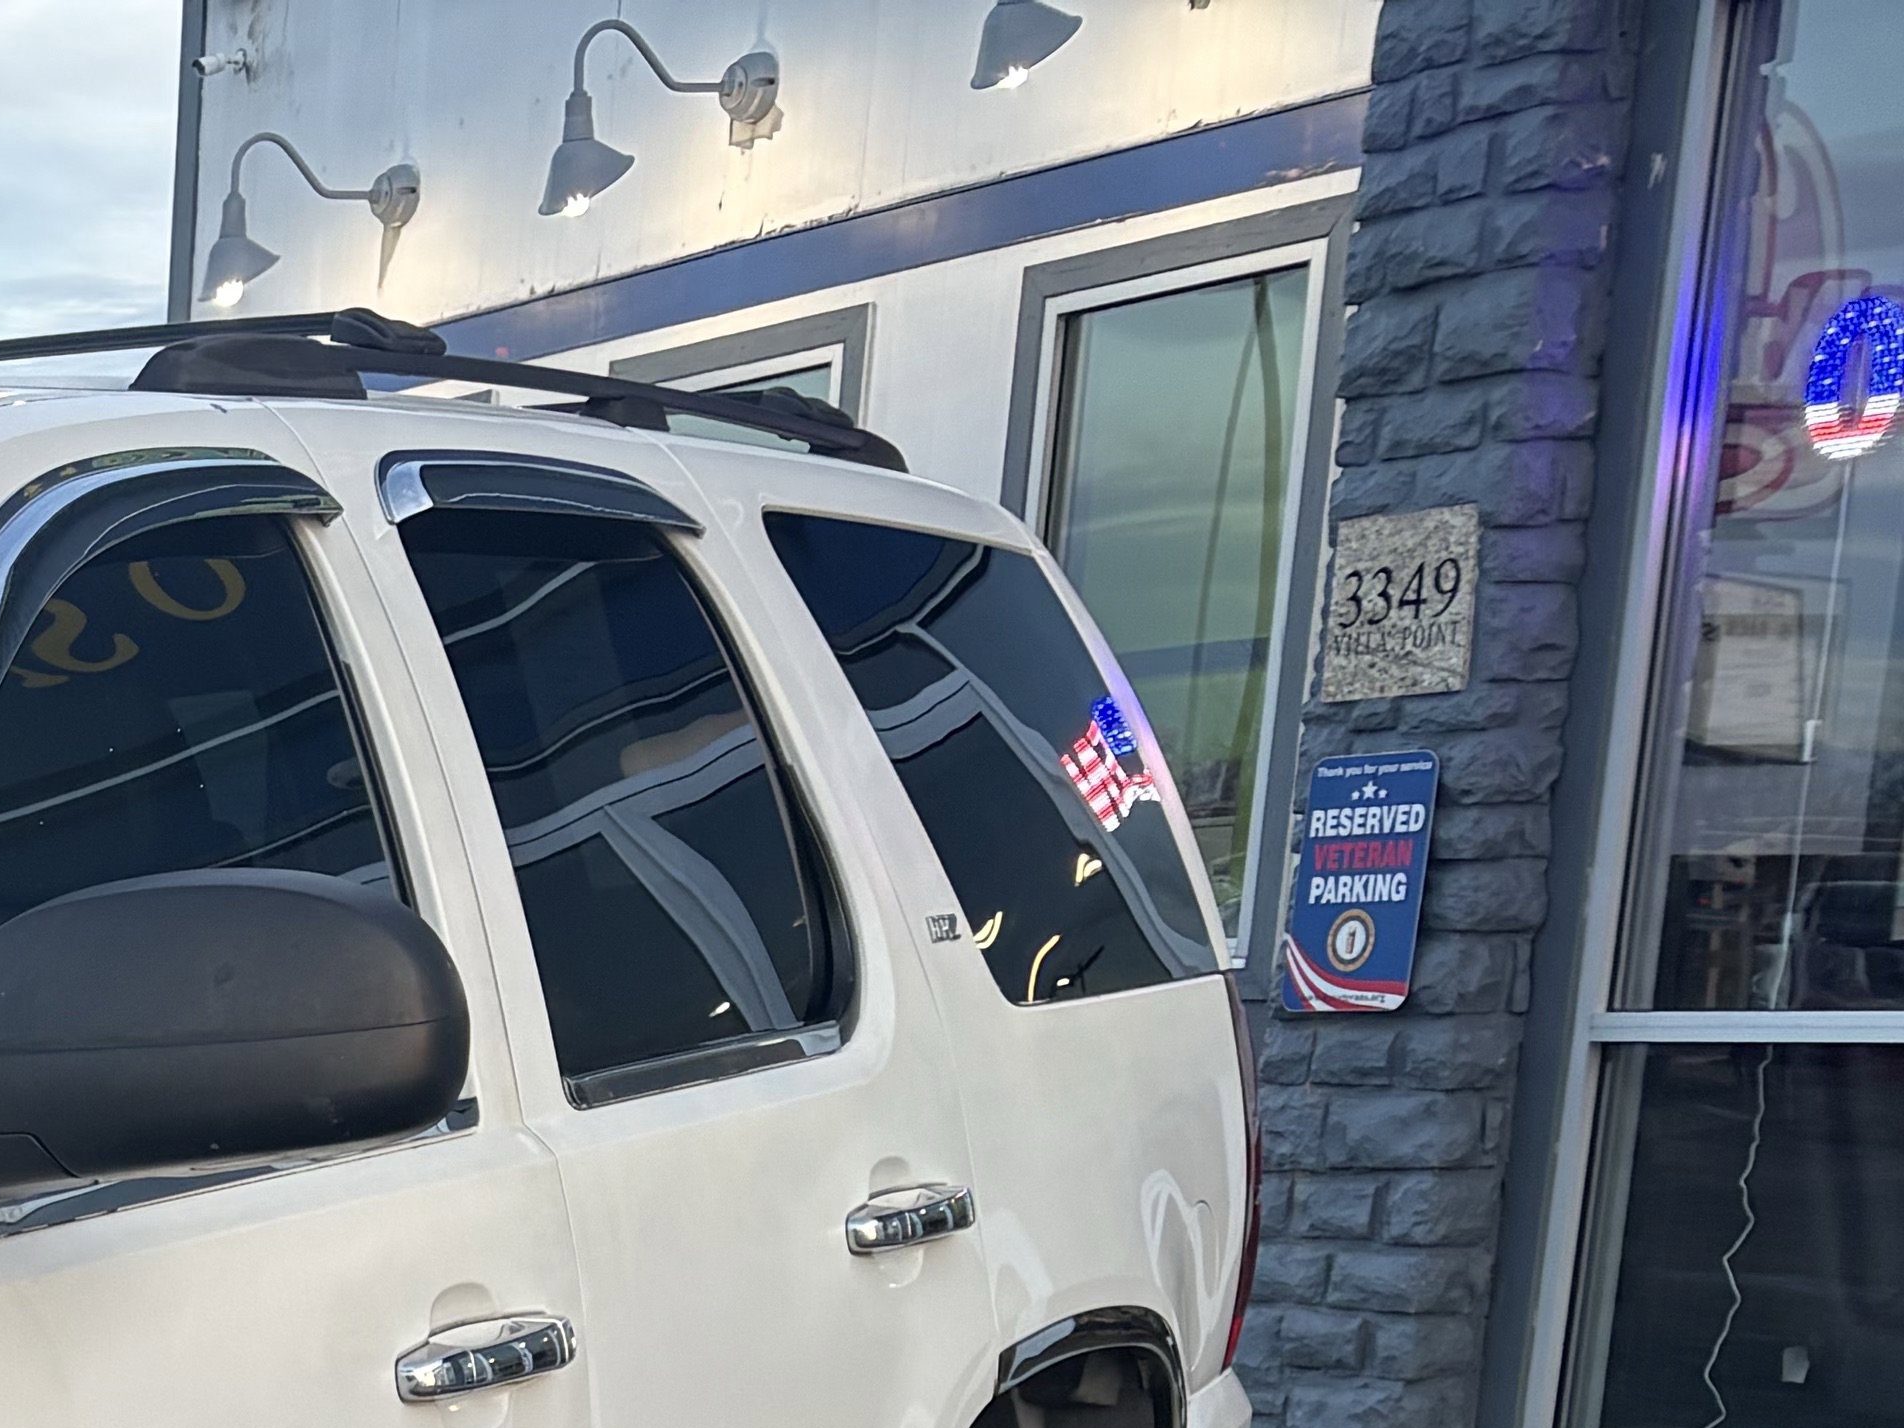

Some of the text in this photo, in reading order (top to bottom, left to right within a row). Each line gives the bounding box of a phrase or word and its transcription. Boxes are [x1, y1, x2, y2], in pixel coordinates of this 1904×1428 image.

[1338, 558, 1461, 629] 3349
[1401, 620, 1464, 650] POINT
[1345, 766, 1363, 778] you
[1309, 804, 1426, 838] RESERVED
[1314, 839, 1414, 872] VETERAN
[1308, 872, 1408, 904] PARKING
